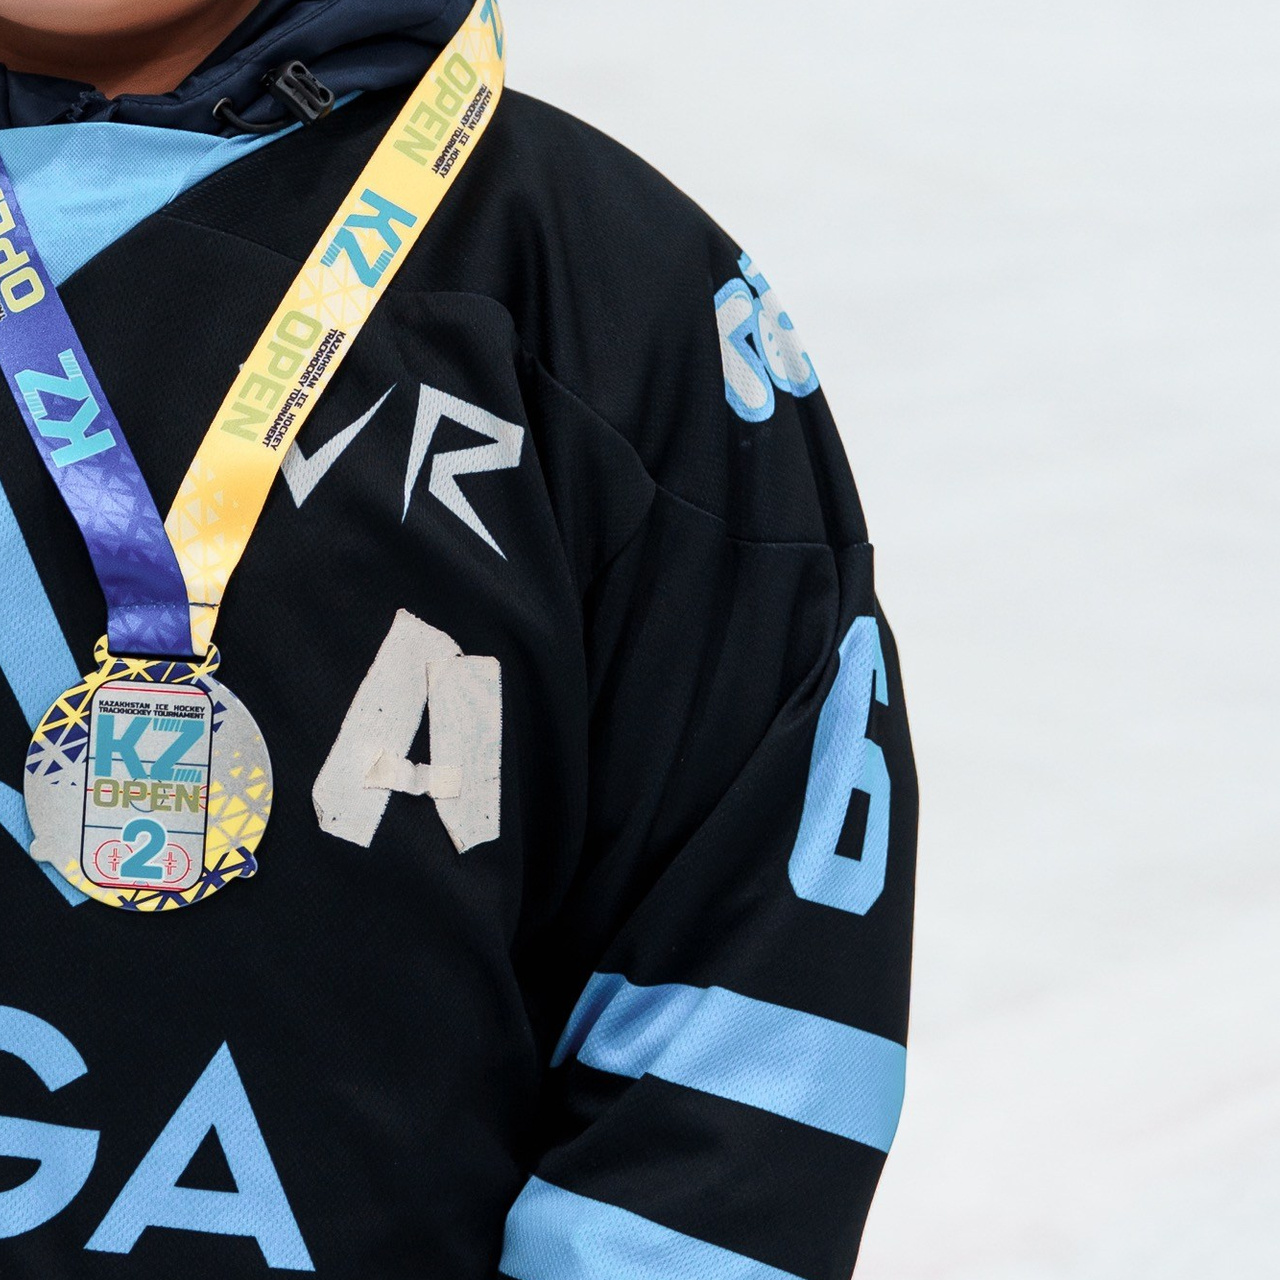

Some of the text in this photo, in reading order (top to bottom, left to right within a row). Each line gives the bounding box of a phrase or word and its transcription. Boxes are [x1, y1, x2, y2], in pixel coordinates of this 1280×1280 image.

[393, 51, 478, 166] OPEN
[431, 126, 462, 174] TOURNAMENT
[439, 90, 493, 179] KAZAKHSTAN ICE HOCKEY
[320, 188, 418, 288] KZ
[14, 348, 116, 468] KZ
[220, 310, 323, 442] OPEN
[262, 388, 301, 448] TOURNAMENT
[270, 331, 347, 451] KAZAKHSTAN ICE HOCKEY
[94, 714, 205, 783] KZ
[98, 700, 206, 713] KAZAKHSTAN ICE HOCKEY
[153, 709, 205, 719] TOURNAMENT
[312, 608, 502, 854] A
[93, 778, 200, 813] OPEN
[788, 616, 891, 916] 6
[120, 818, 166, 880] 2
